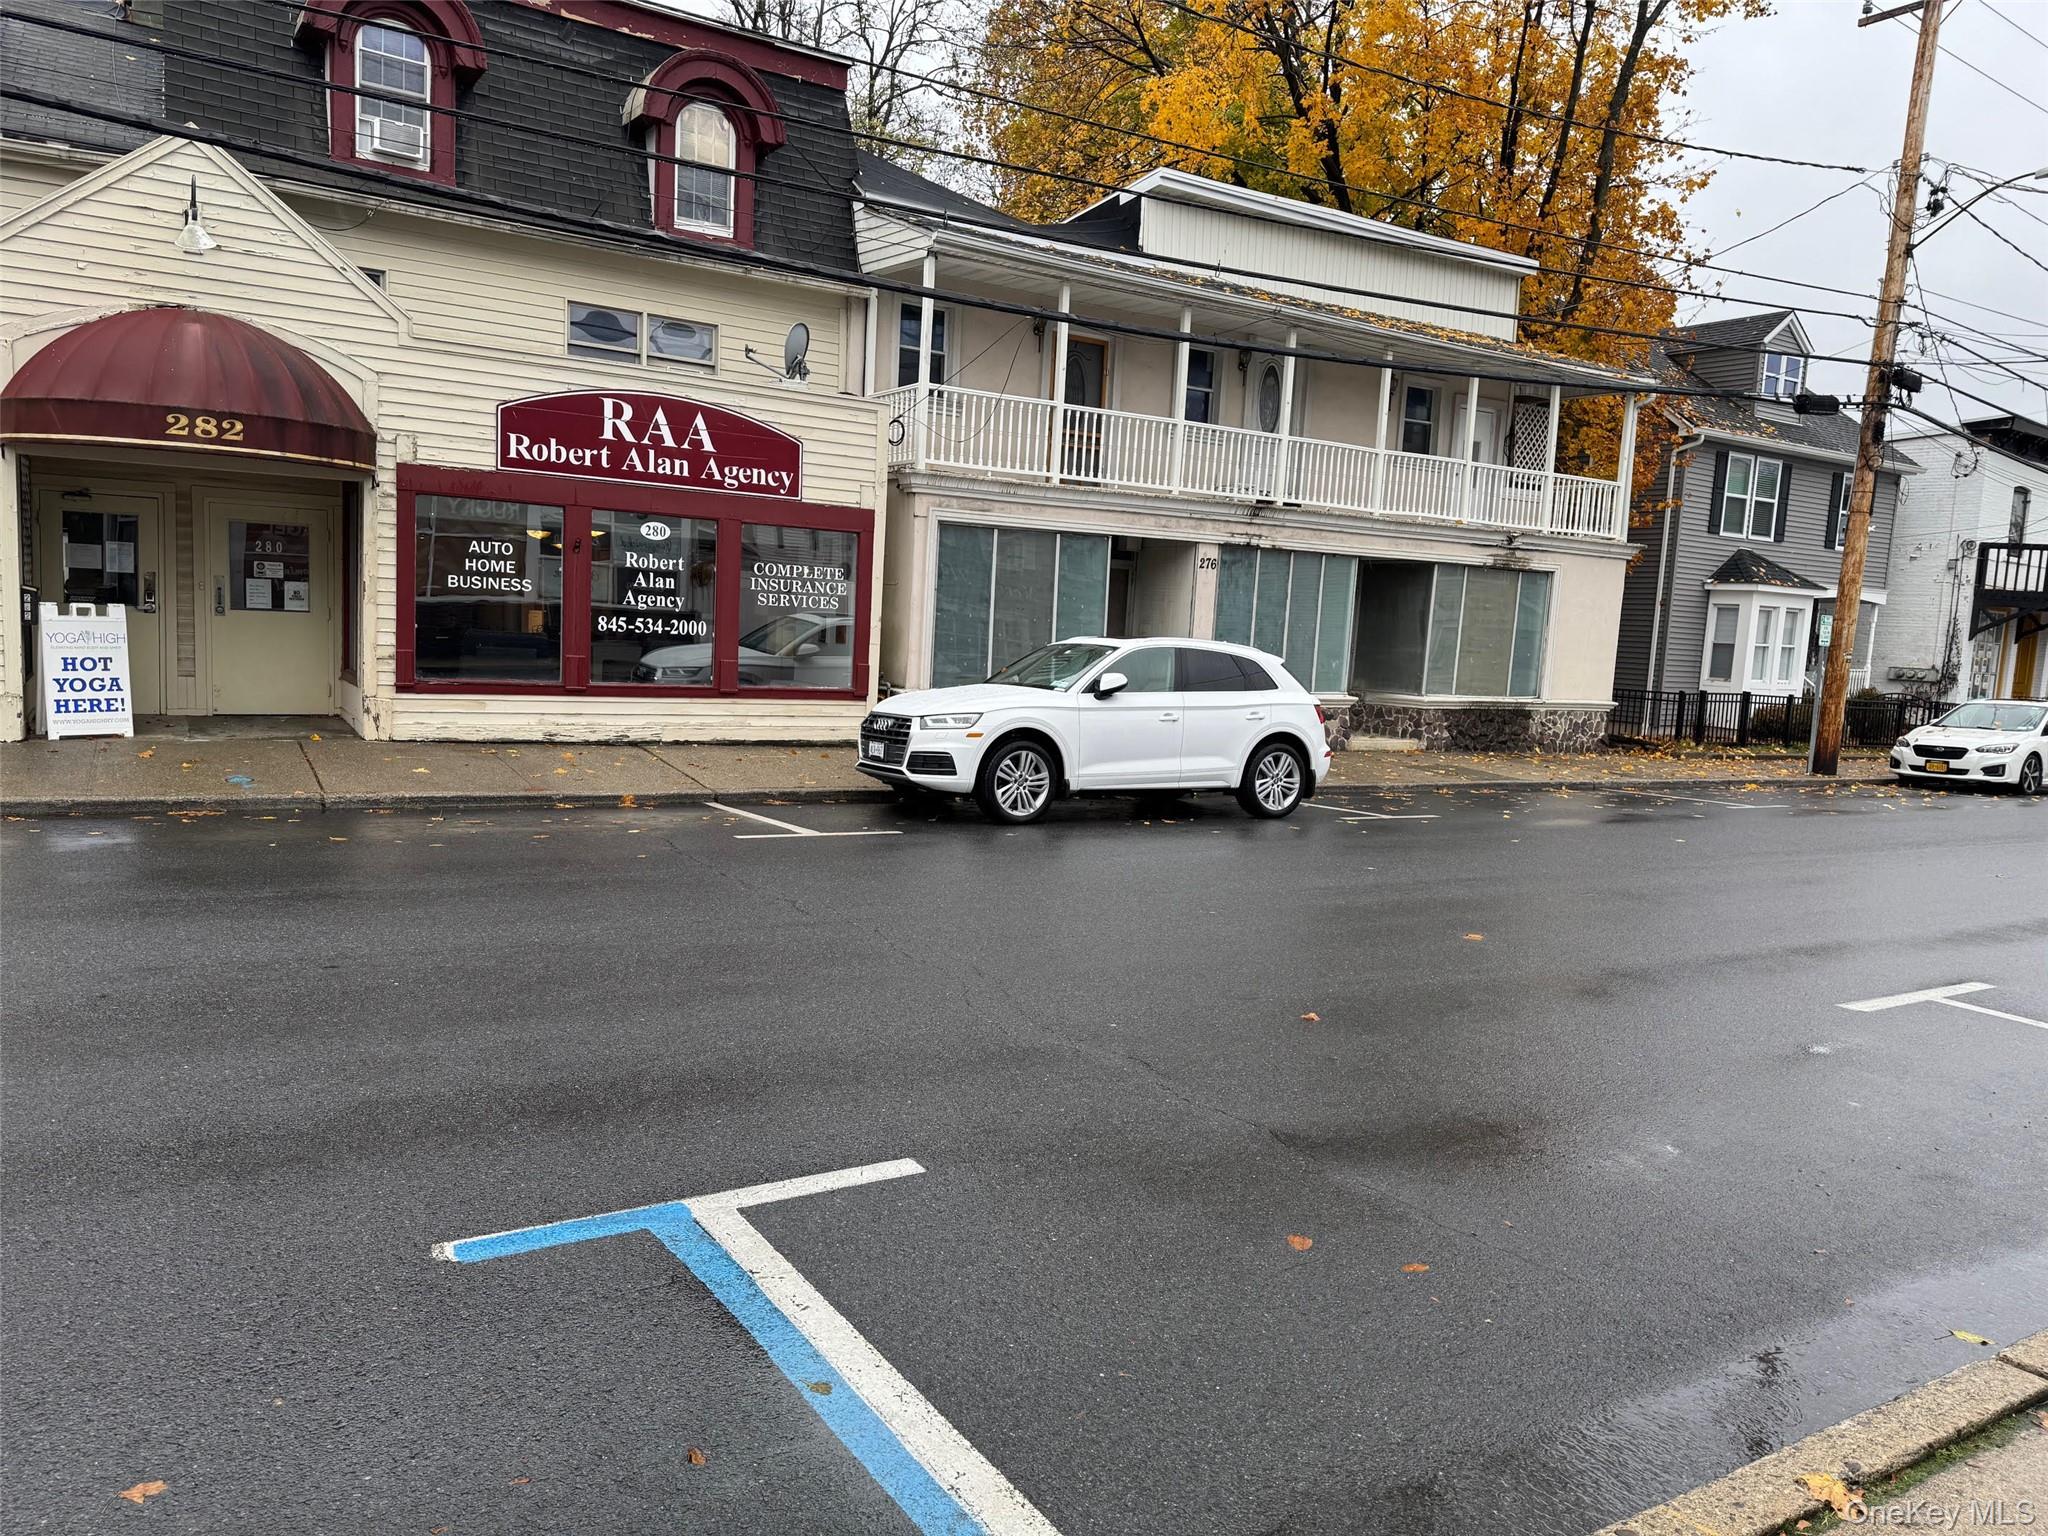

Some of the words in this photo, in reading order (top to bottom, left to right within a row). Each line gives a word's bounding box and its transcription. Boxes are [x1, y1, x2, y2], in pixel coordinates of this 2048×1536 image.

[164, 413, 244, 441] 282
[598, 396, 718, 453] RAA
[506, 432, 612, 470] Robert
[620, 447, 690, 478] Alan
[700, 456, 795, 495] Agency
[644, 524, 667, 538] 280
[255, 540, 283, 553] 280
[468, 540, 514, 556] AUTO
[464, 558, 516, 574] HOME
[625, 551, 685, 571] Robert
[1199, 557, 1217, 570] 276
[633, 571, 676, 589] Alan
[753, 562, 845, 581] COMPLETE
[447, 574, 533, 592] BUSINESS
[750, 577, 848, 595] INSURANCE
[622, 589, 685, 612] Agency
[757, 592, 840, 610] SERVICES
[597, 615, 708, 636] 845-534-2000
[46, 631, 88, 644] YOGA
[92, 631, 126, 644] HIGH
[61, 656, 113, 672] HOT
[52, 677, 124, 693] YOGA
[53, 698, 126, 714] HERE!
